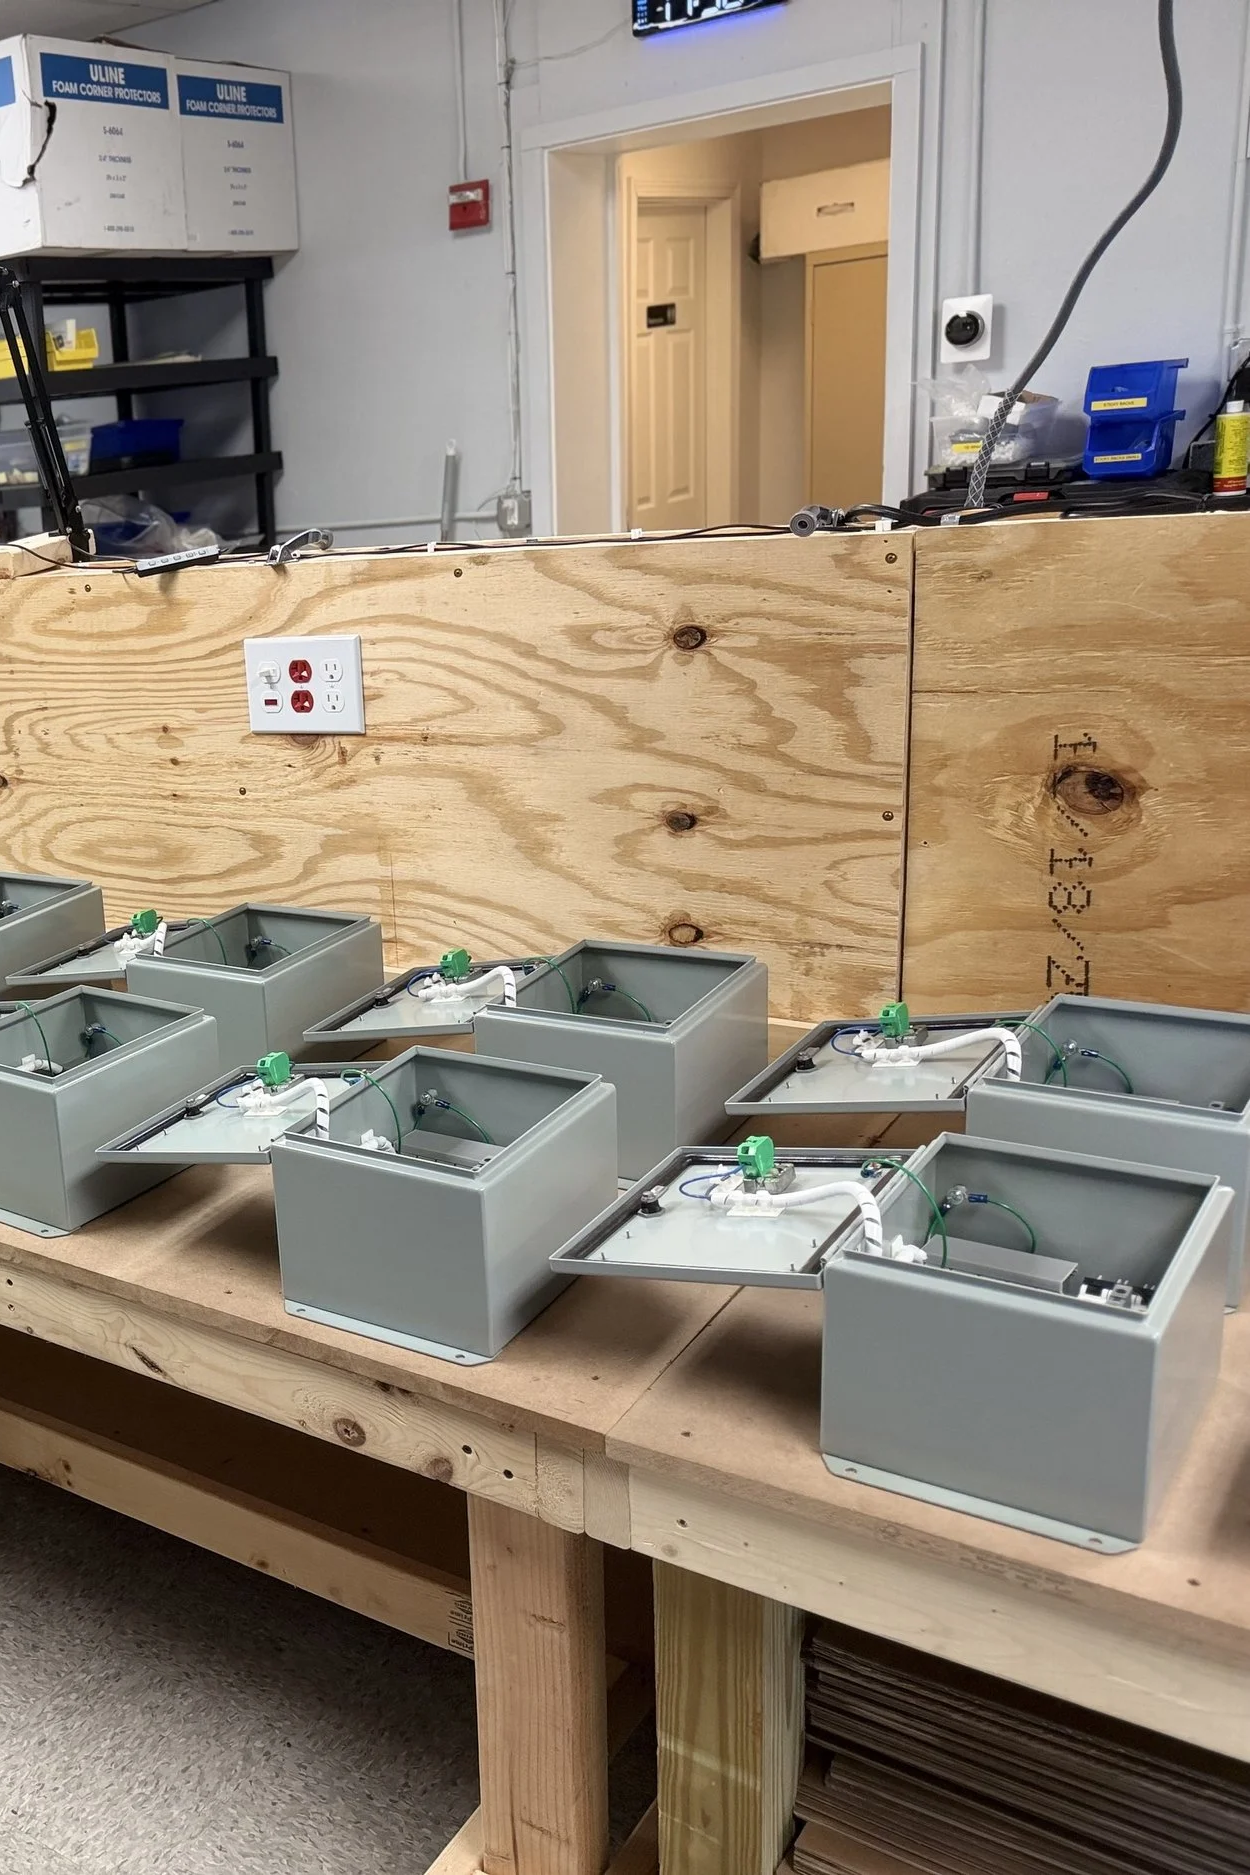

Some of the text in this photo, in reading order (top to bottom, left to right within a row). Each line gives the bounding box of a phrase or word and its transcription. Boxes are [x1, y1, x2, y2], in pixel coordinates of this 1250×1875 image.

[89, 63, 126, 84] ULINE
[52, 80, 162, 104] FOAM CORNER PROTECTORS
[216, 84, 247, 102] ULINE
[186, 99, 277, 119] FOAM CORNER PROTECTORS
